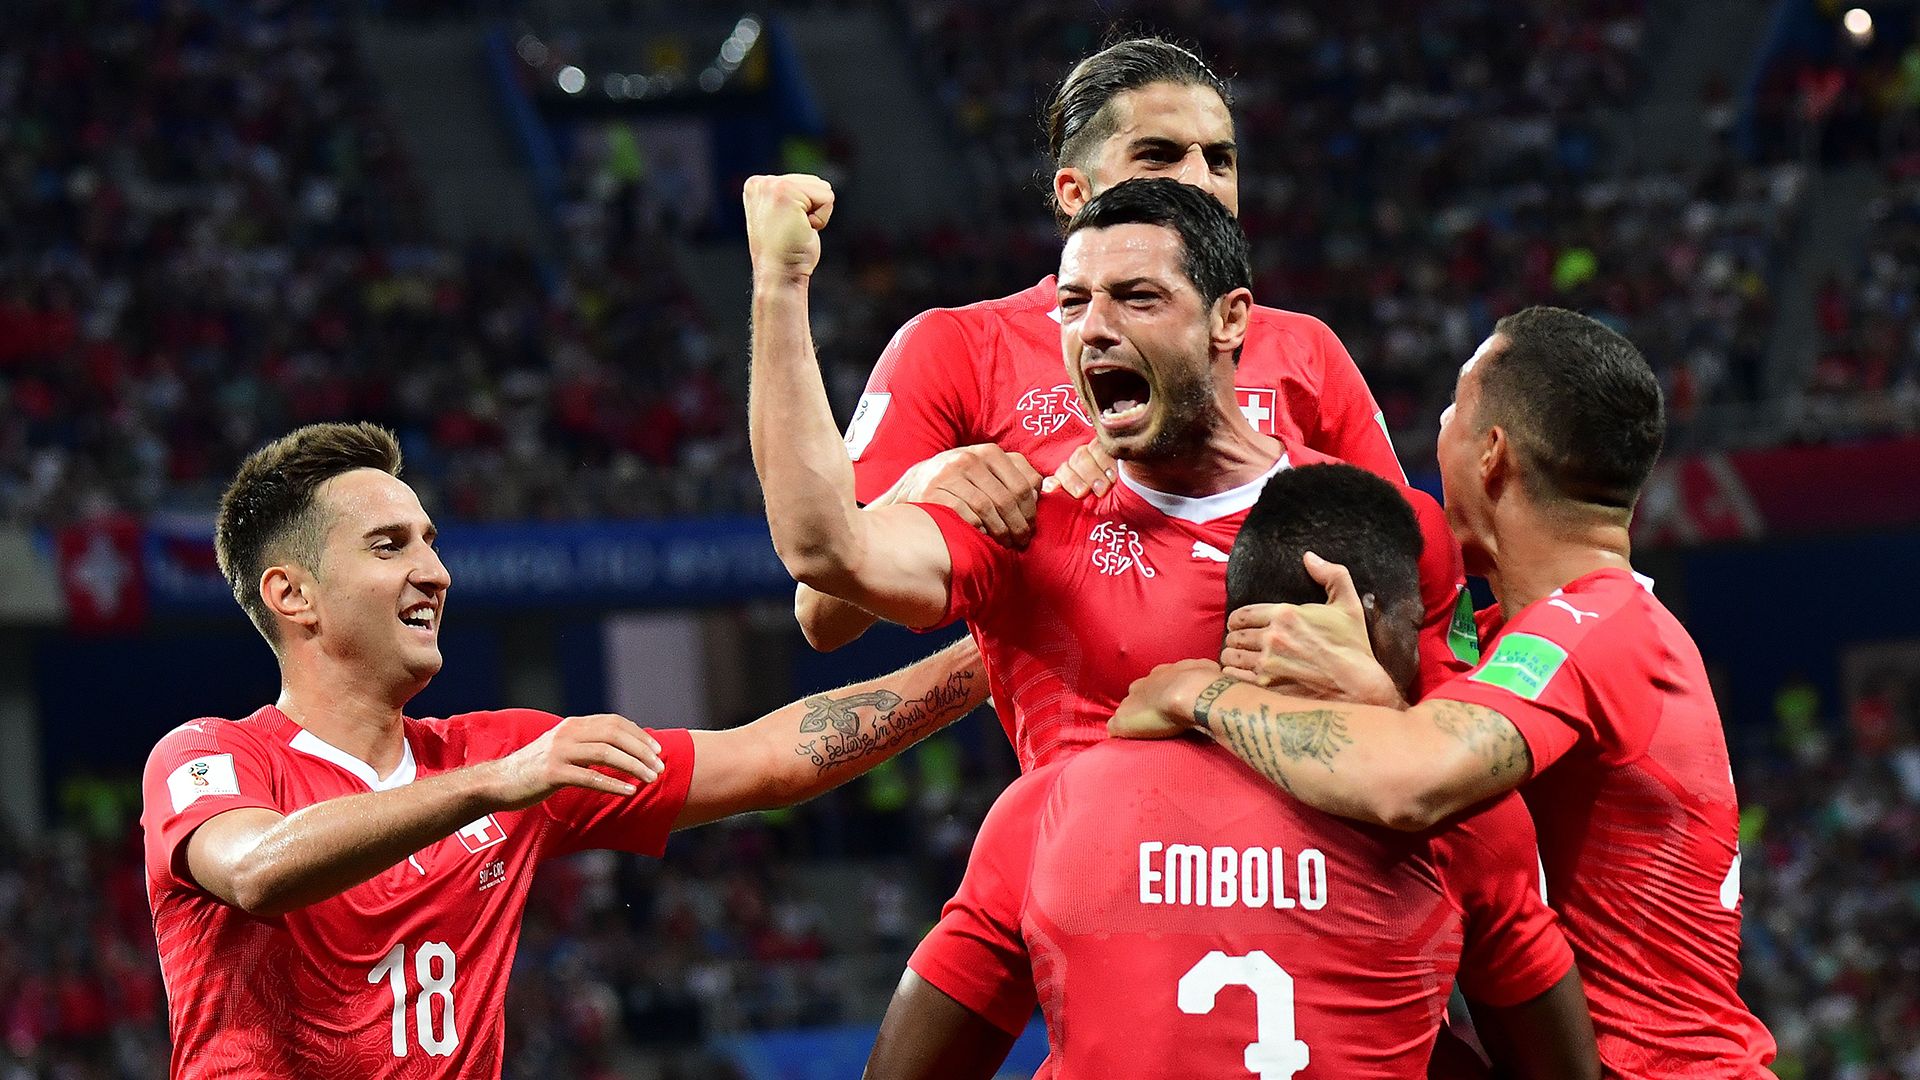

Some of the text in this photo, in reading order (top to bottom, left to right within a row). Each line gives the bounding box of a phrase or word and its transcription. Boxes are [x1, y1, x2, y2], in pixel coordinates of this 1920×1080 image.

[921, 673, 973, 713] Christ
[873, 715, 890, 742] in
[881, 708, 927, 735] Jesus
[822, 731, 875, 762] believe
[1139, 841, 1327, 910] EMBOLO
[367, 941, 459, 1057] 18
[1177, 949, 1310, 1080] 7
